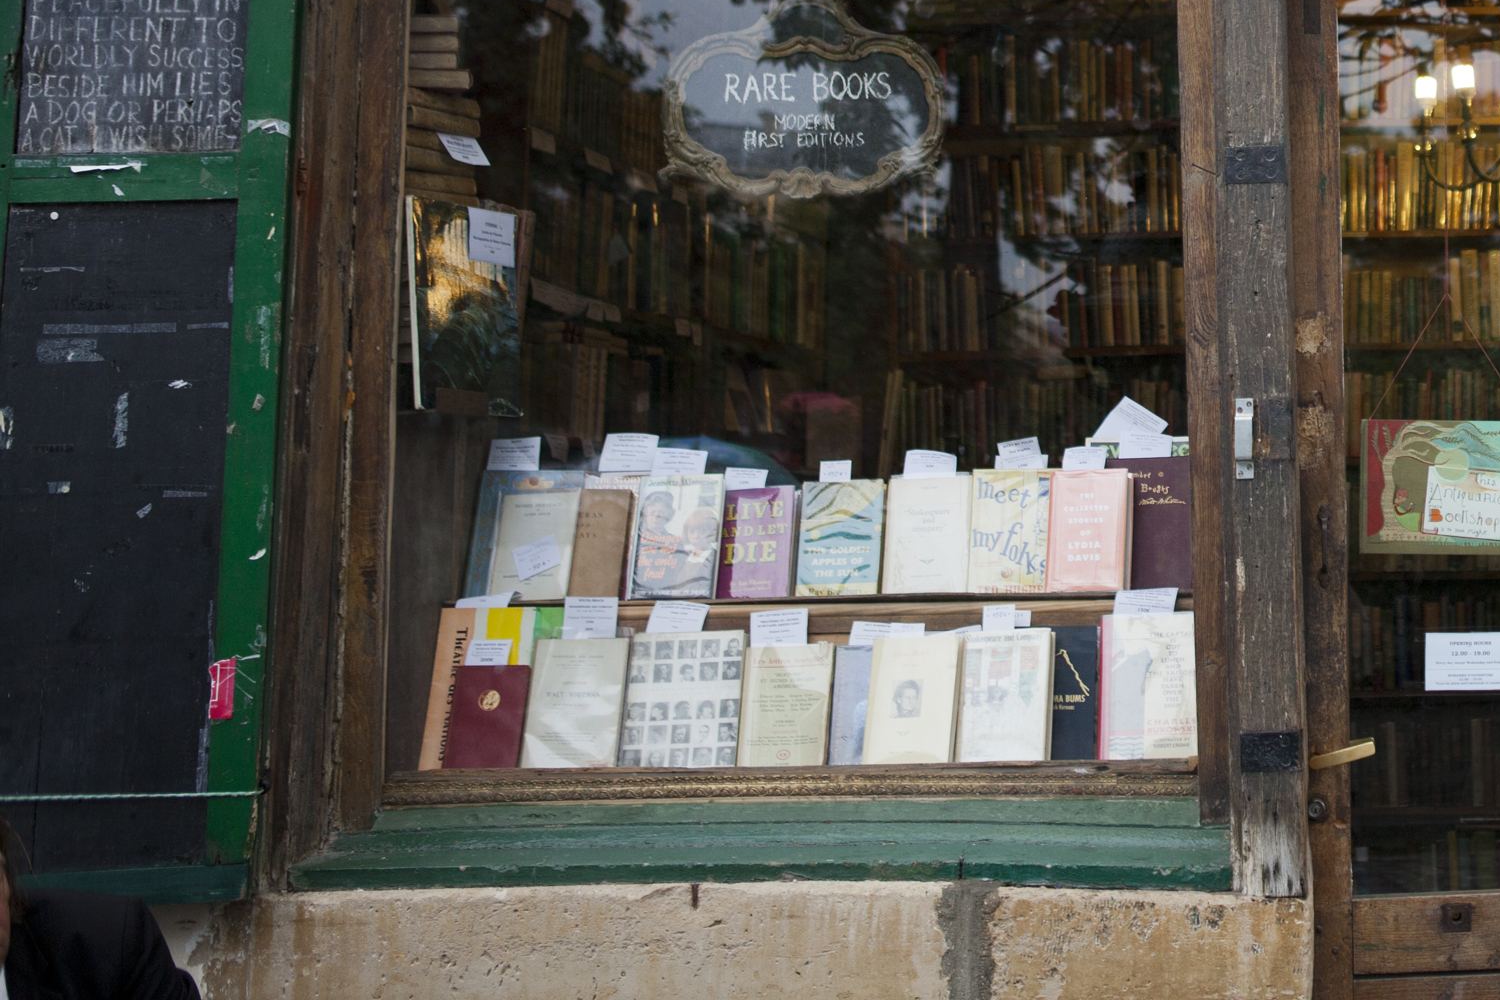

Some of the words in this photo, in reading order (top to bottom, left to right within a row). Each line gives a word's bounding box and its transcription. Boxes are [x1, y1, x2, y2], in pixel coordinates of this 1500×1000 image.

[27, 72, 109, 99] BESIDE
[175, 71, 231, 97] LIES
[724, 72, 797, 105] RARE
[812, 71, 892, 103] BOOKS
[774, 113, 836, 131] MODERN
[796, 131, 866, 148] EDITIONS
[648, 479, 680, 487] Jeanette
[681, 478, 719, 487] Winterson
[976, 477, 1032, 509] meet
[726, 500, 785, 522] LIVE
[721, 526, 754, 539] AND
[758, 523, 789, 536] LET
[972, 528, 1004, 552] my
[1067, 541, 1101, 549] LYDIA
[723, 540, 778, 566] DIE
[829, 545, 870, 554] GOLDEN
[1067, 553, 1101, 562] DAVIS
[811, 557, 847, 566] APPLES
[851, 556, 864, 565] OF
[814, 569, 834, 578] THE
[837, 569, 859, 577] SUN
[966, 634, 1001, 643] Shakespeare
[1003, 633, 1015, 642] and
[1016, 632, 1043, 643] Company
[1065, 694, 1086, 703] BUMS
